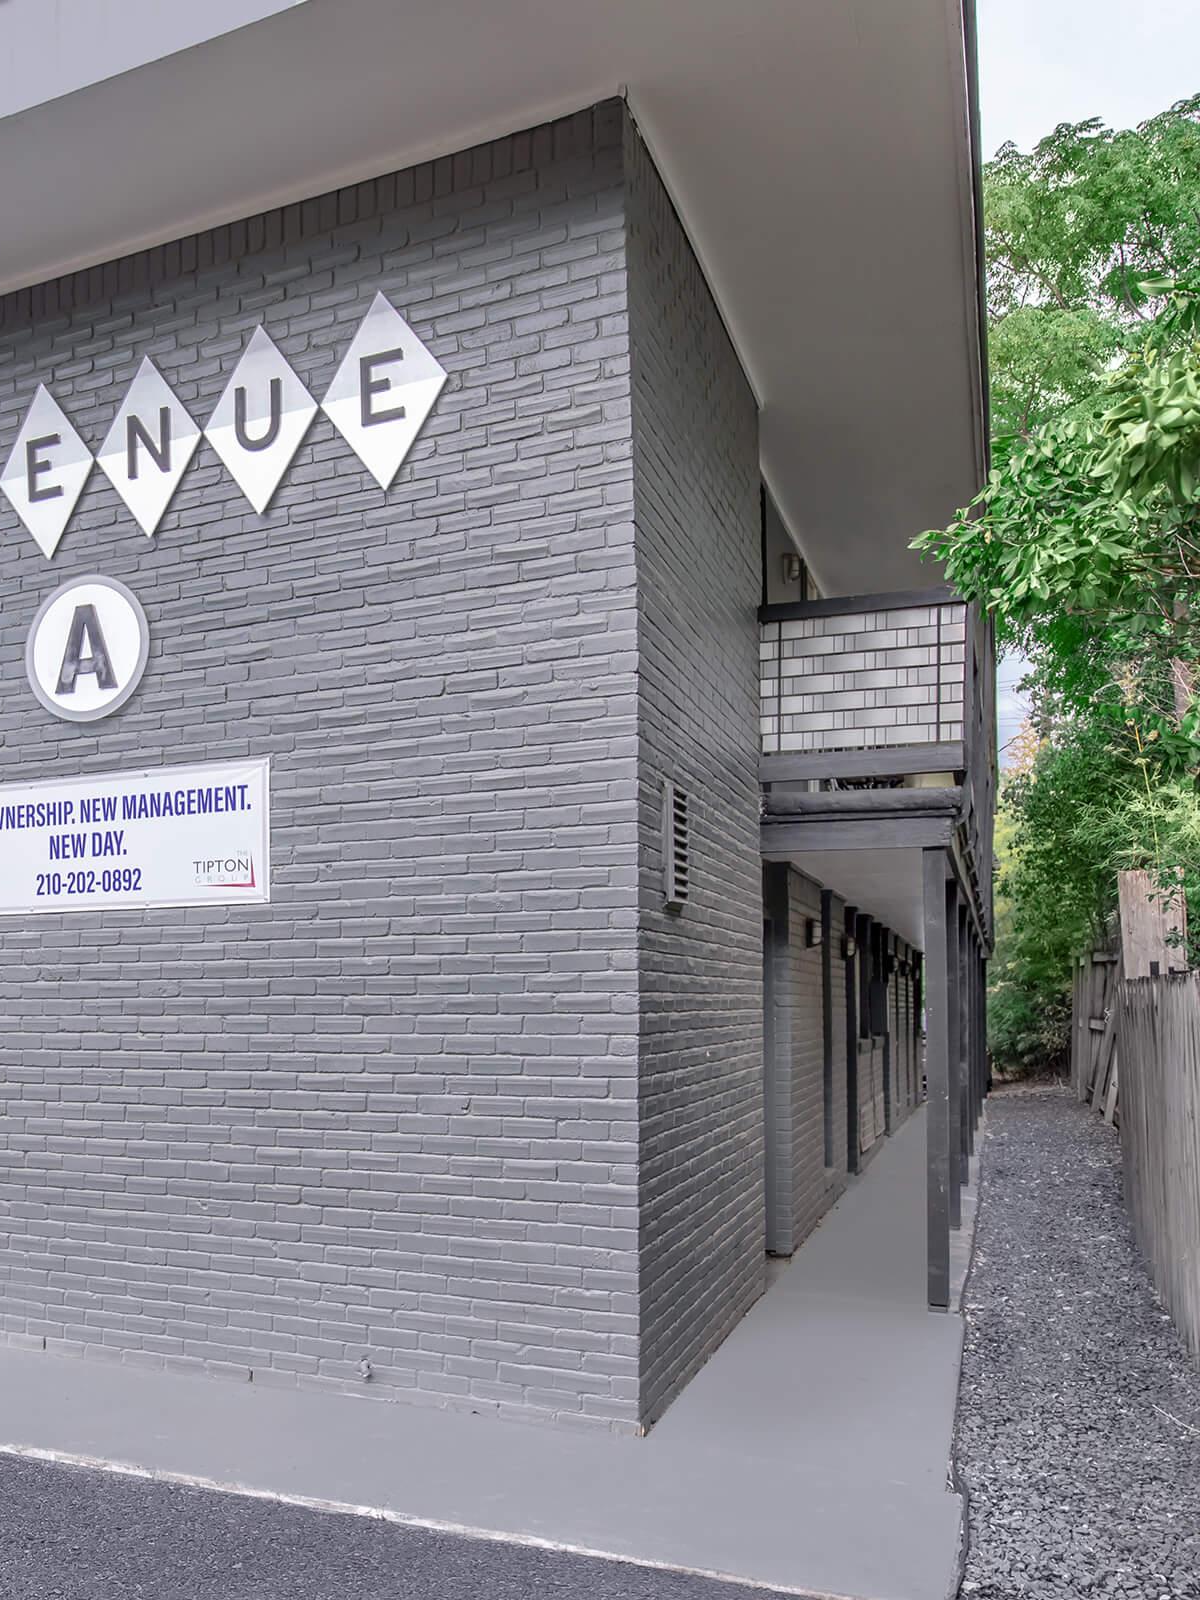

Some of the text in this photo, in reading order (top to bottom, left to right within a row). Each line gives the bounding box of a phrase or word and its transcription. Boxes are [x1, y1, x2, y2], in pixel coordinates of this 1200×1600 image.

[54, 602, 119, 695] A
[79, 795, 117, 824] NEW
[121, 784, 252, 820] MANAGEMENT.
[49, 830, 127, 860] NEW DAY.
[192, 858, 249, 874] TIPTON
[194, 873, 249, 883] GROUP
[36, 867, 142, 896] 210-202-0892
